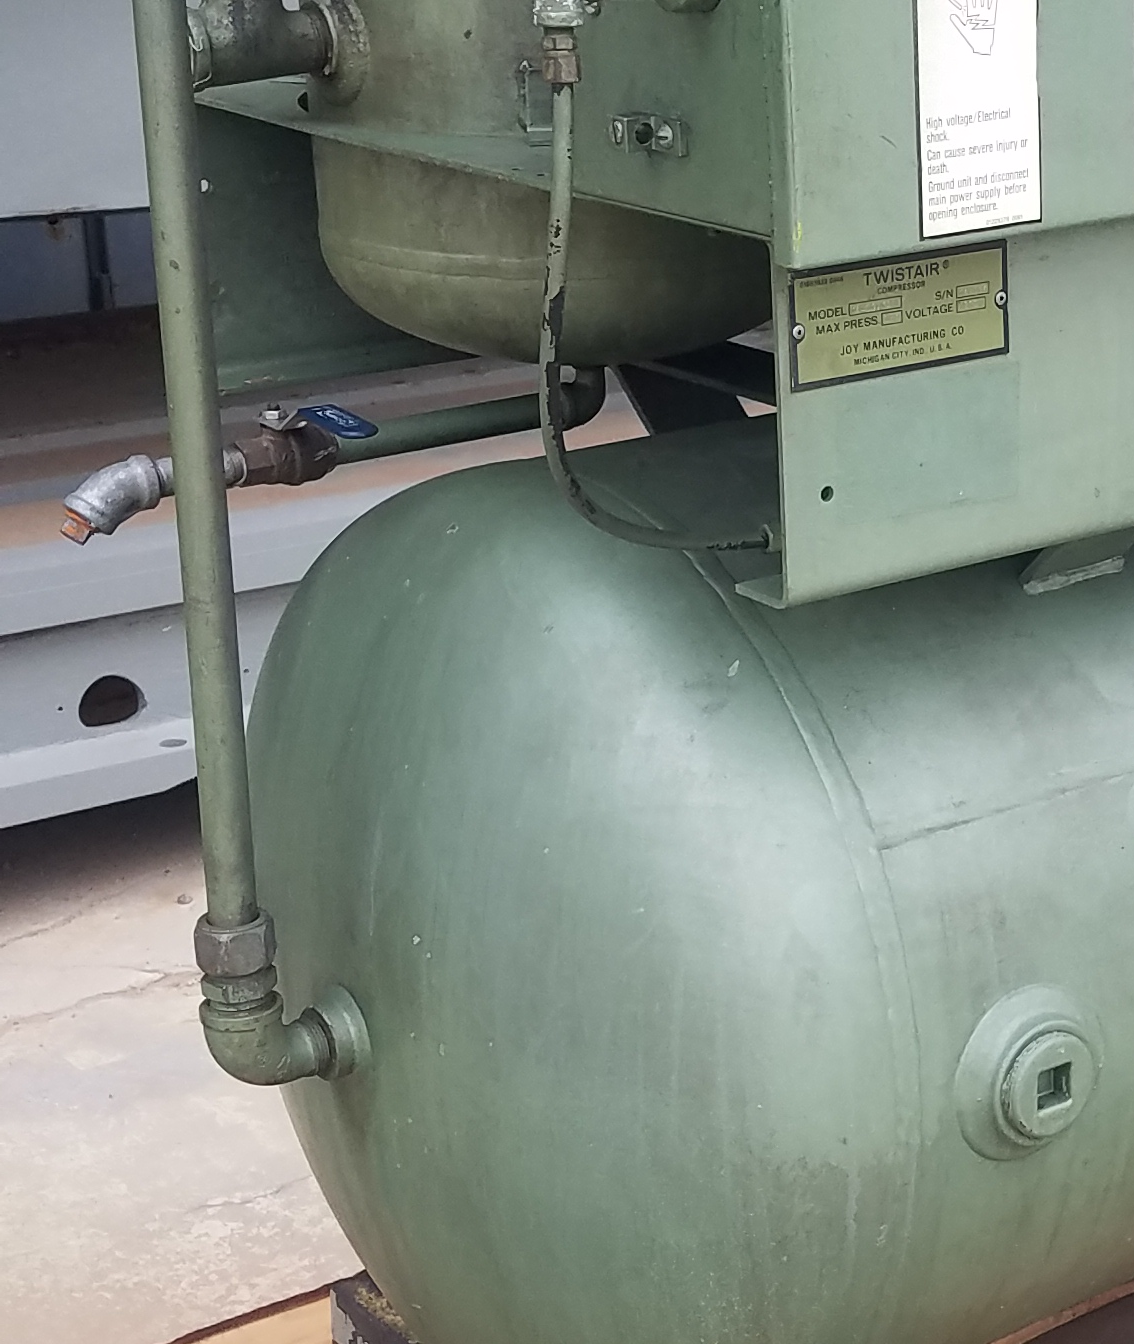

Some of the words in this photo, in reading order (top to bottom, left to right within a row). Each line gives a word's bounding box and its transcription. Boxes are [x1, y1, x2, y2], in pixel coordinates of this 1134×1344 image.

[926, 117, 943, 130] High
[927, 149, 940, 161] Can
[944, 147, 965, 158] cause
[968, 143, 993, 155] severe
[996, 139, 1018, 153] injury
[1021, 139, 1028, 148] or
[929, 178, 954, 193] Ground
[958, 176, 972, 188] unit
[974, 173, 987, 185] and
[991, 168, 1029, 183] disconnect
[929, 194, 946, 206] main
[949, 192, 972, 206] power
[976, 186, 1001, 200] supply
[1004, 183, 1026, 195] before
[929, 207, 958, 222] opening
[877, 280, 926, 294] COMPRESSOR
[935, 289, 954, 300] S/N
[808, 307, 847, 321] MODEL
[905, 303, 953, 319] VOLTAGE
[815, 322, 841, 335] MAX
[844, 315, 878, 330] PRESS
[840, 344, 859, 356] JOY
[863, 328, 946, 351] MANUFACTURING
[951, 325, 964, 336] CO
[854, 353, 890, 366] MICHIGAN
